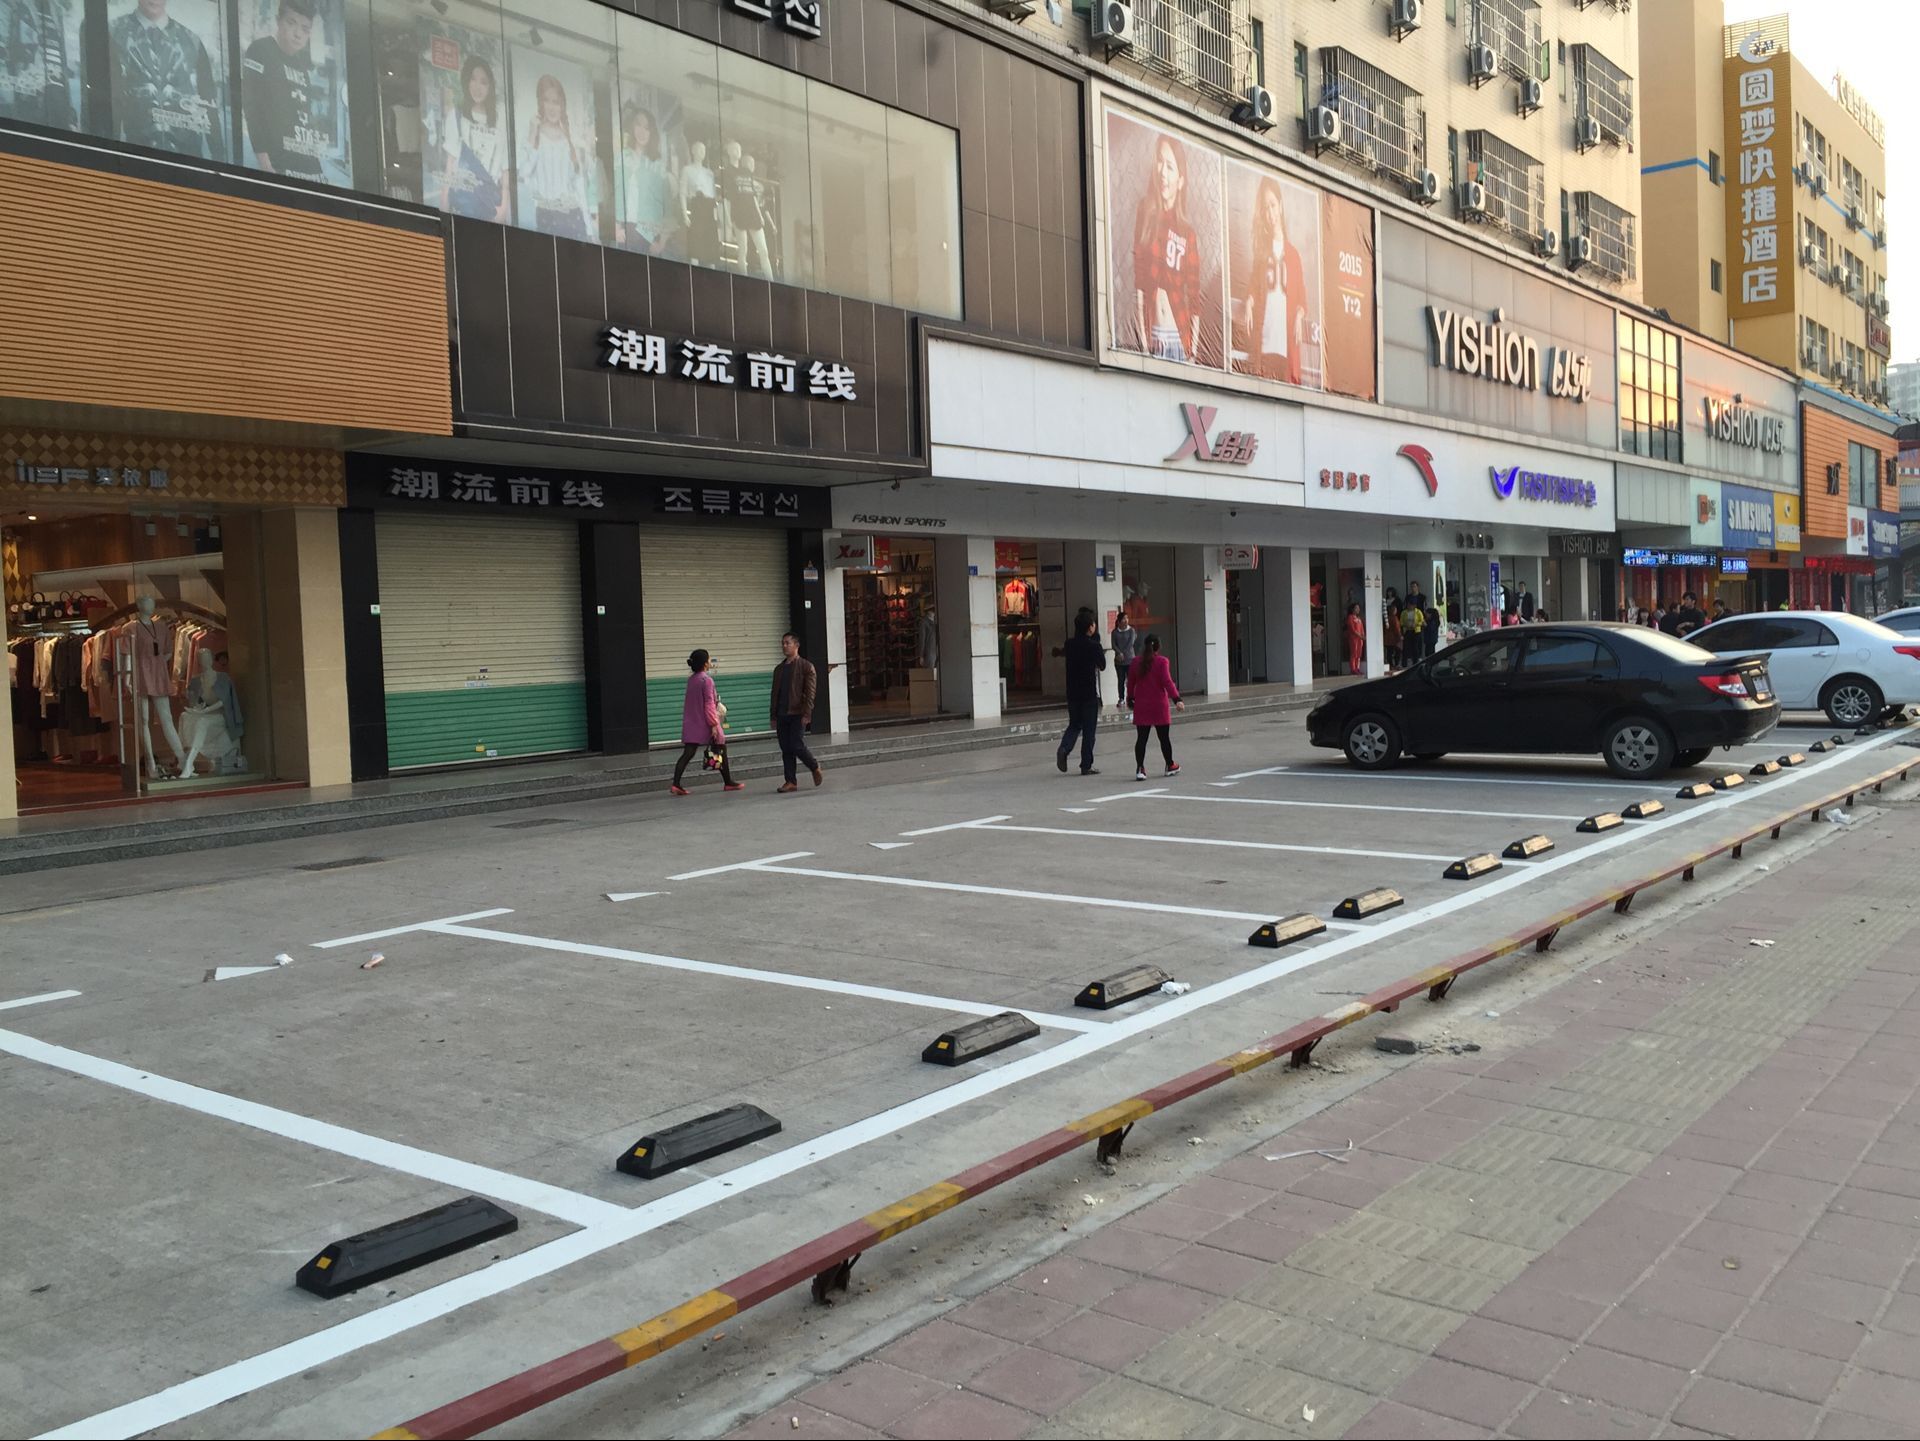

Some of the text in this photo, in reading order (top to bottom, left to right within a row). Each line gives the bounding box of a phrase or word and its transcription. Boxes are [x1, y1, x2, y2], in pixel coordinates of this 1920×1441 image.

[734, 0, 821, 36] 선
[1739, 68, 1777, 303] 圆梦快捷酒店
[1166, 239, 1185, 271] 97
[1339, 250, 1362, 277] 2015
[606, 326, 857, 401] 潮流前线
[391, 467, 799, 518] 潮流前线 조류전선
[852, 514, 947, 528] FASHION SPORTS
[1727, 499, 1772, 533] SAMSUNG
